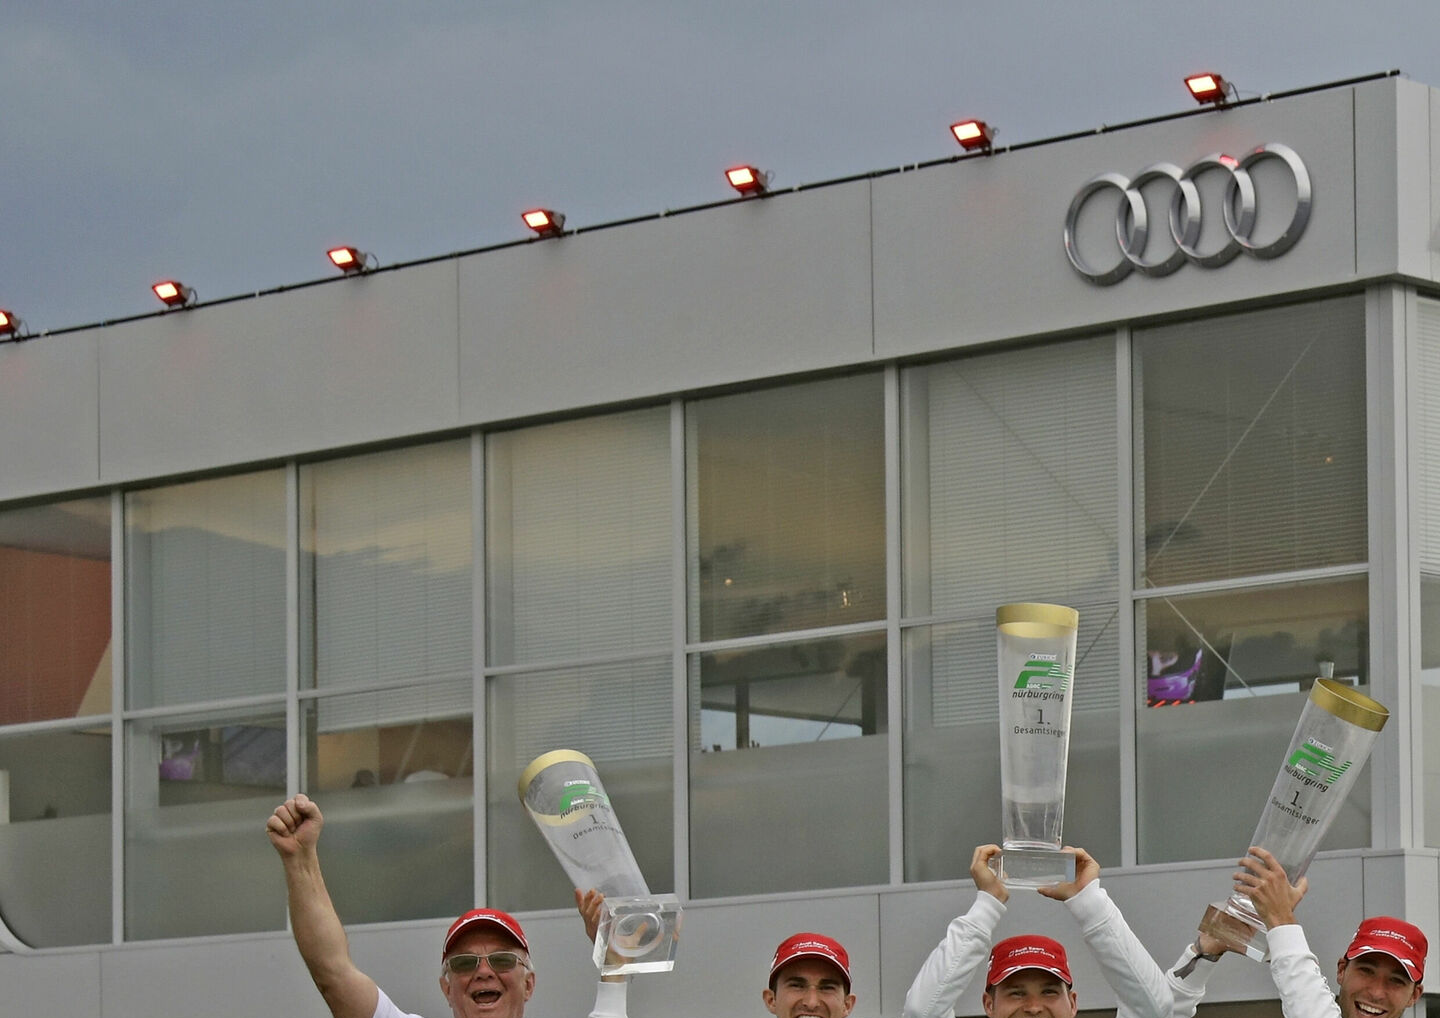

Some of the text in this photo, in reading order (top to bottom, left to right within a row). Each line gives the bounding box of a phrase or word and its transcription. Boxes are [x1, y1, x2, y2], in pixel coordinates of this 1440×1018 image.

[1012, 690, 1065, 702] nürburgring
[1036, 708, 1051, 725] 1.
[1290, 790, 1303, 809] 1.
